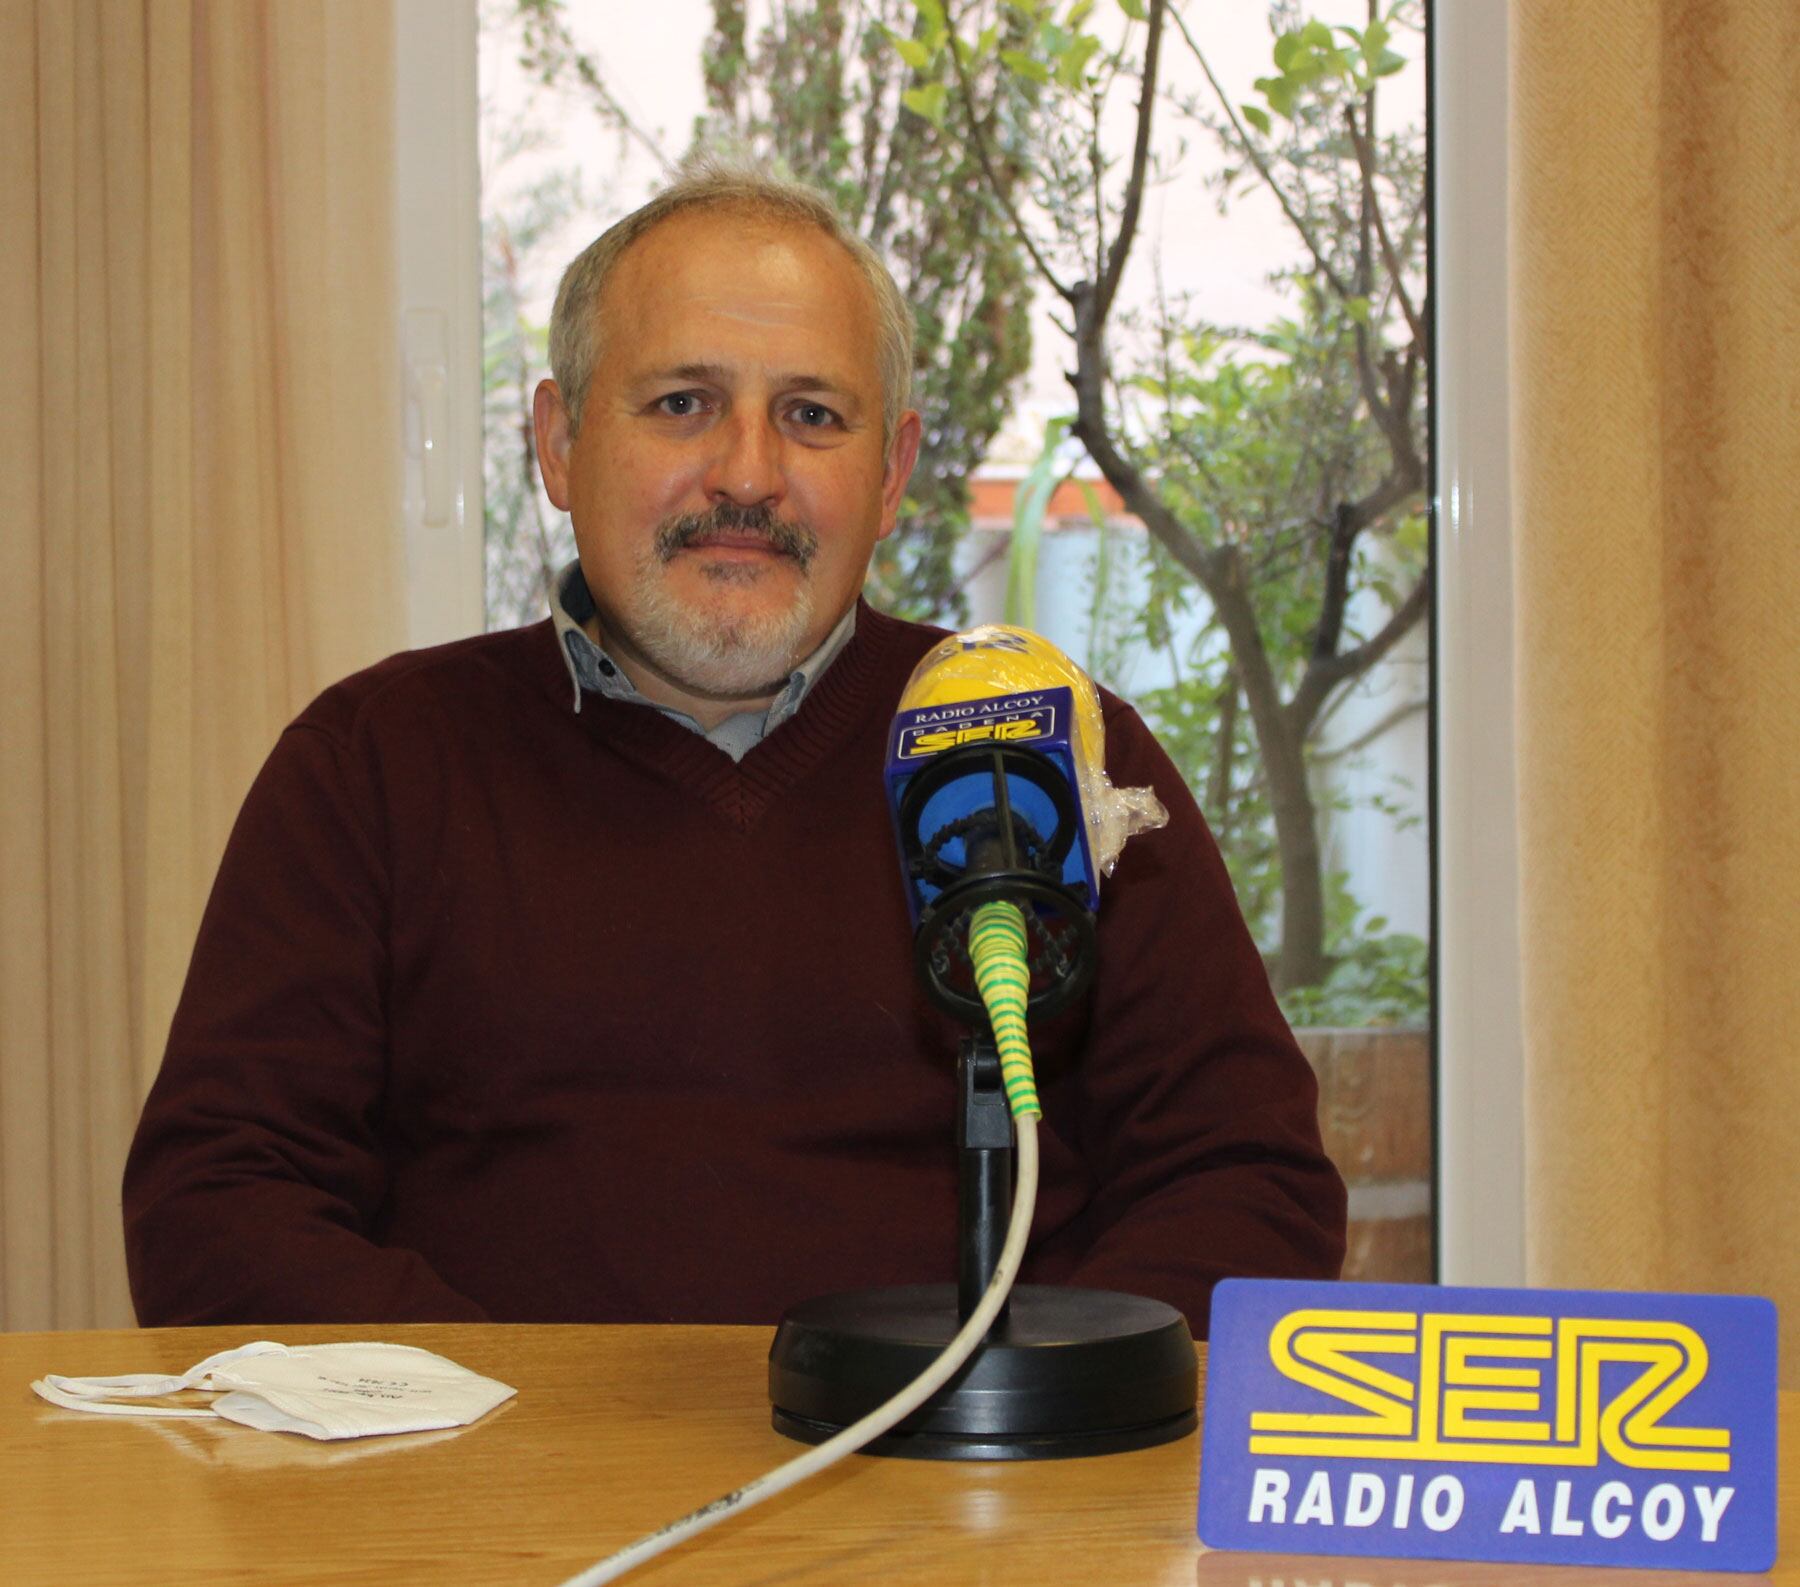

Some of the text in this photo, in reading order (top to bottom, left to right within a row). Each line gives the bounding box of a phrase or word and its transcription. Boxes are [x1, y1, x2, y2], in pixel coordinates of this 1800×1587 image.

[915, 697, 1044, 723] RADIO ALCOY
[910, 720, 1042, 755] SER
[1248, 1308, 1731, 1472] SER
[1248, 1468, 1735, 1542] RADIO ALCOY
